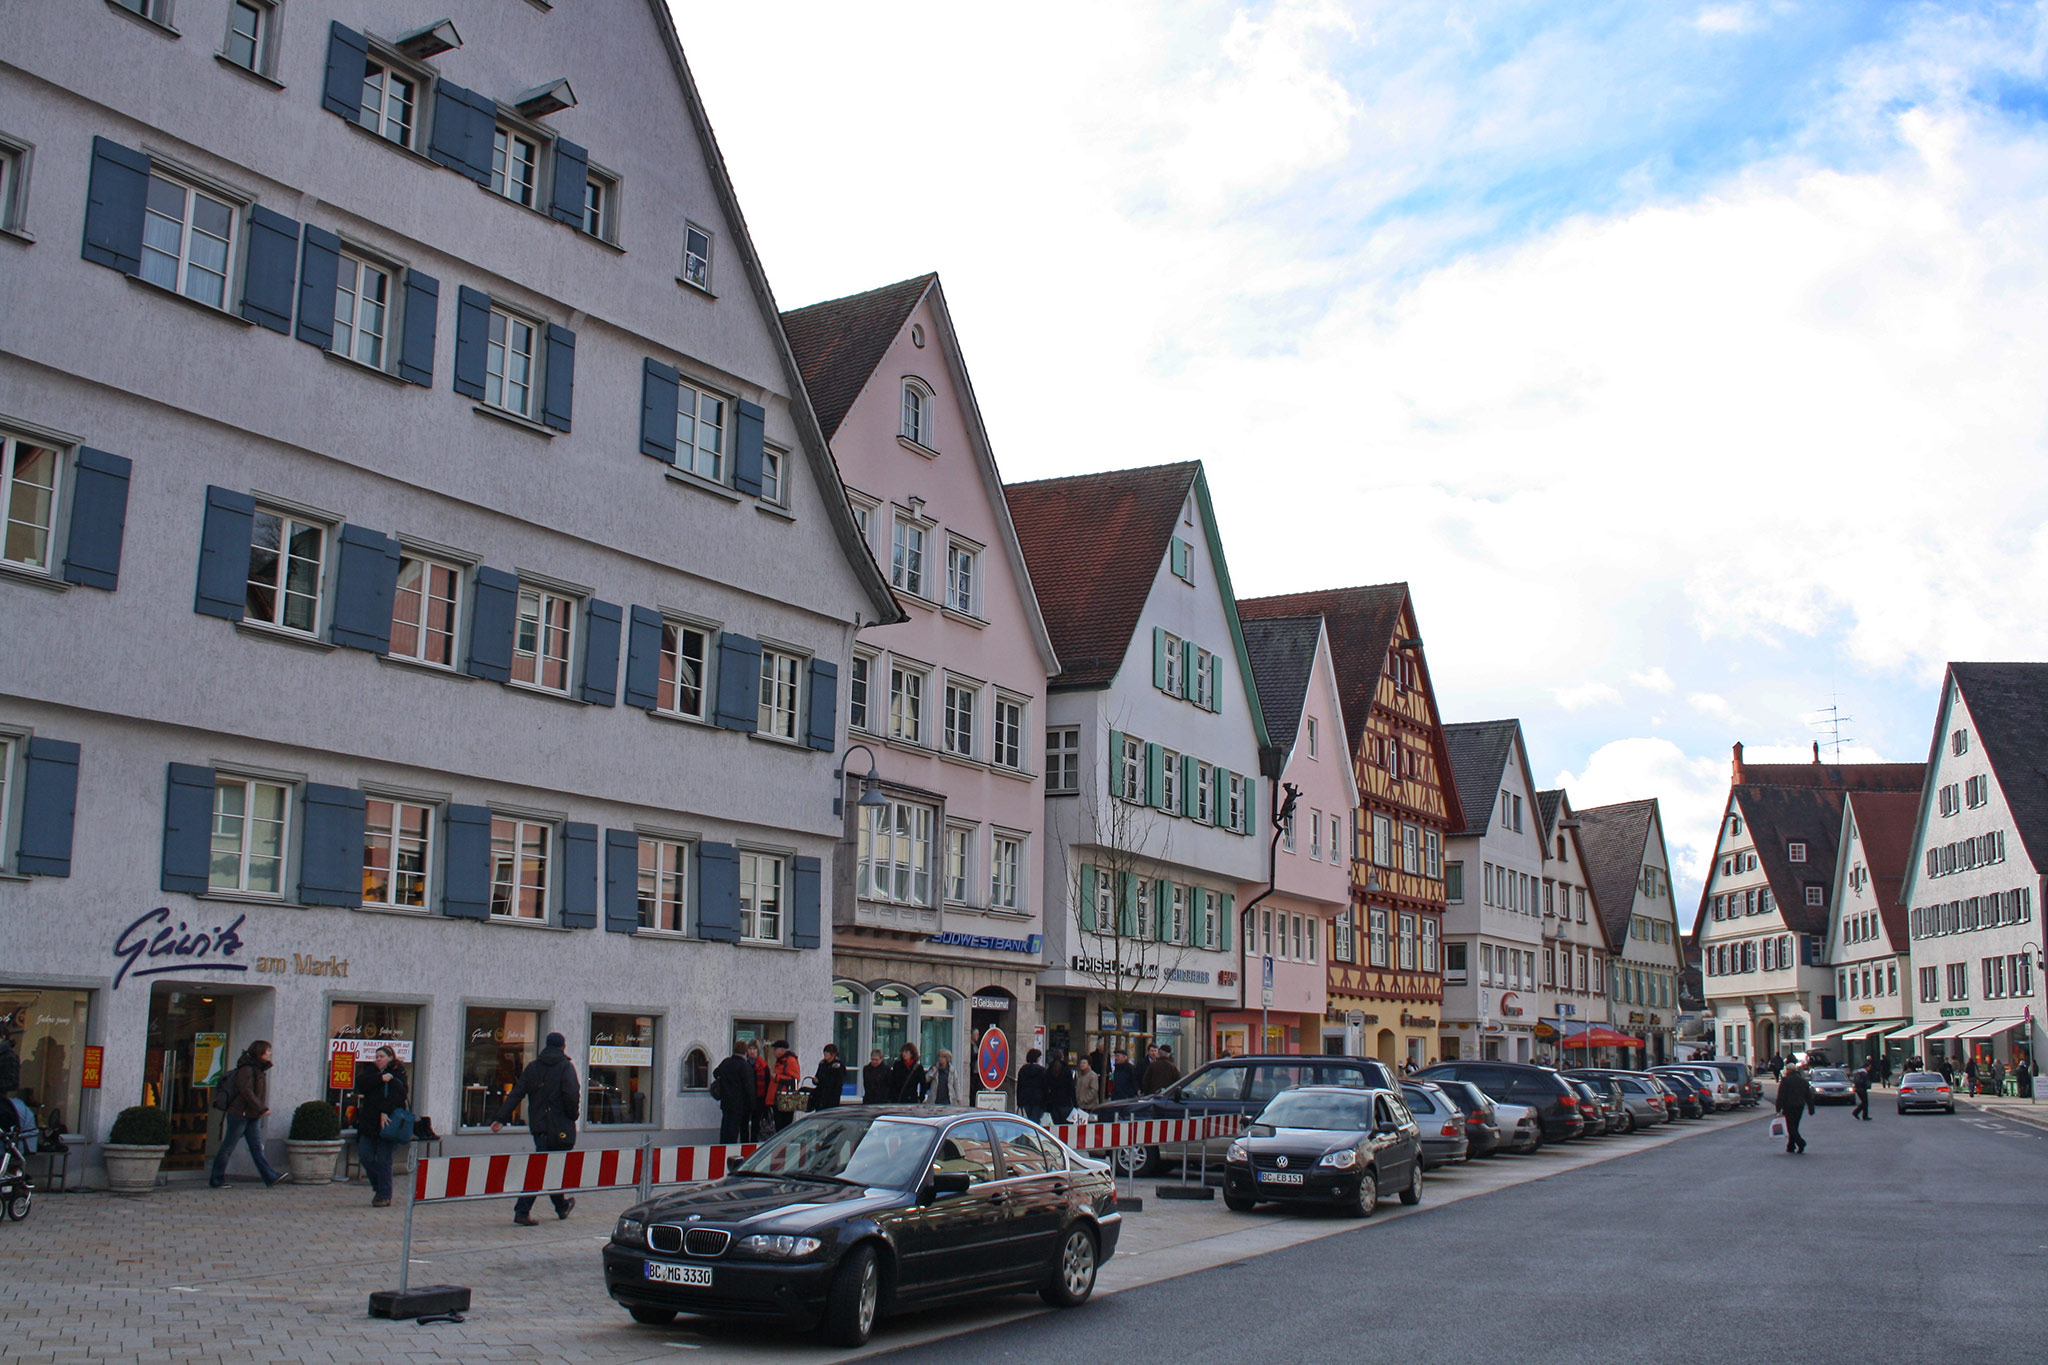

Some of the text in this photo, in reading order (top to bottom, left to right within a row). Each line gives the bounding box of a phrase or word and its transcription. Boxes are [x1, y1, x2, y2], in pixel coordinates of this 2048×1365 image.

[256, 955, 286, 973] am
[293, 953, 349, 977] Markt
[1264, 959, 1271, 977] P
[591, 1047, 603, 1064] 20
[333, 1070, 352, 1082] 20%
[667, 1266, 681, 1281] MG
[683, 1268, 711, 1284] 3330
